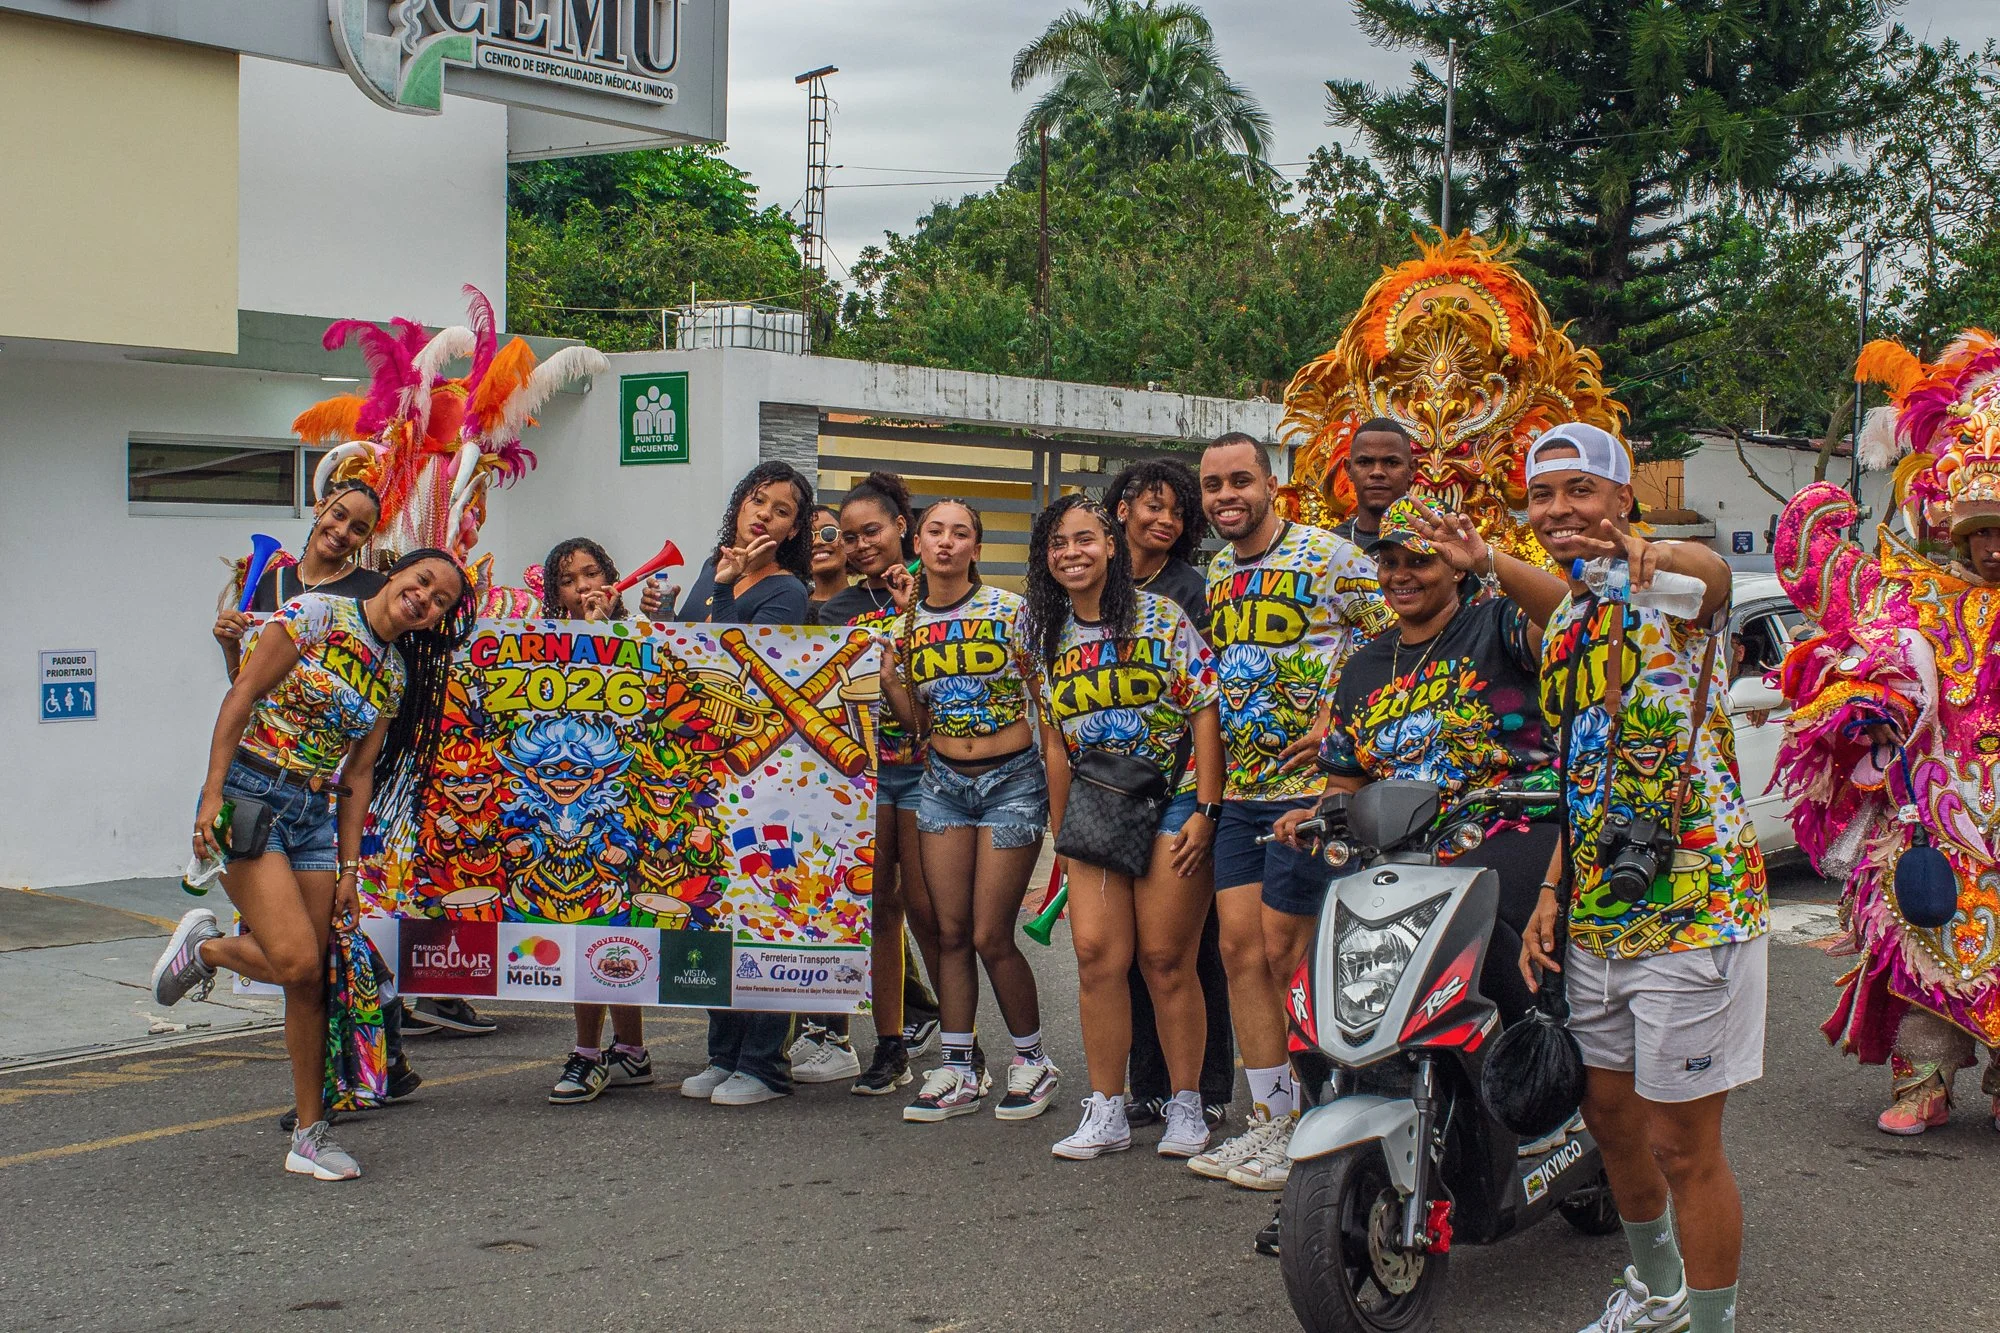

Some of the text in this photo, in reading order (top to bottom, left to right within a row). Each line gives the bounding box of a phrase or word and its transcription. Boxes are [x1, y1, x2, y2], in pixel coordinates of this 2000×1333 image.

[484, 51, 674, 100] CENTRO DE ESPECIALIDADES MÉDICAS UNIDOS
[630, 444, 679, 453] ENCUENTRO
[634, 434, 675, 443] PUNTO DE
[1209, 570, 1313, 611] ARNAVAL
[847, 606, 902, 626] CARNAV
[909, 620, 1010, 649] RNAVAL
[52, 656, 87, 666] PARQUEO
[470, 632, 663, 674] CARNAVAL
[1052, 637, 1169, 678] ARNAVAL
[46, 667, 93, 678] PRIORITARIO
[321, 645, 391, 711] KND
[483, 665, 648, 716] 2026
[1051, 667, 1163, 719] KND
[1364, 677, 1449, 729] 2026
[411, 951, 491, 969] LIQUOR
[584, 936, 653, 962] AGROVETERINARIA
[799, 954, 841, 966] Transporte
[506, 970, 562, 987] Melba
[674, 975, 717, 986] PALMERAS
[683, 969, 707, 977] VISTA
[769, 964, 829, 987] Goyo
[1541, 1139, 1583, 1183] KYMCO
